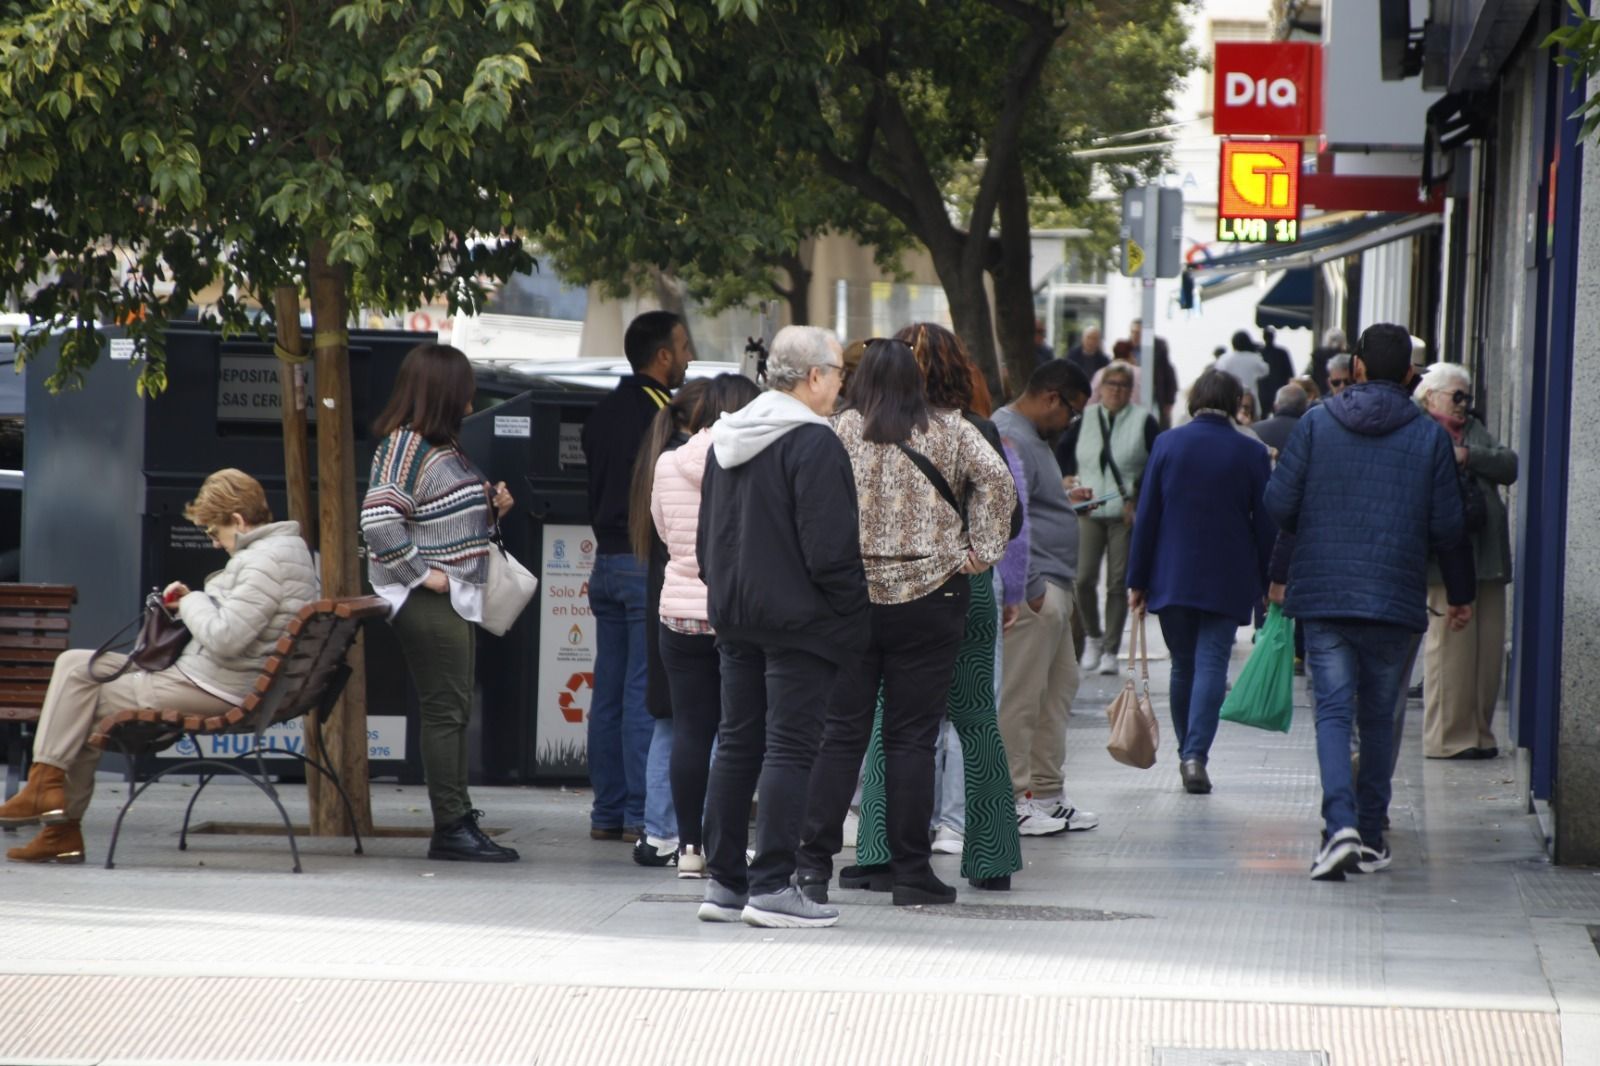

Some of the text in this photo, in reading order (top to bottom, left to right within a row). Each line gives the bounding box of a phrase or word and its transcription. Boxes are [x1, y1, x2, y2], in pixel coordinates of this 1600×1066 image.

[1225, 72, 1297, 106] Dia
[218, 367, 281, 384] EPOSITA
[549, 581, 589, 598] Solo A
[552, 603, 593, 617] en bot
[212, 733, 305, 755] HUELV
